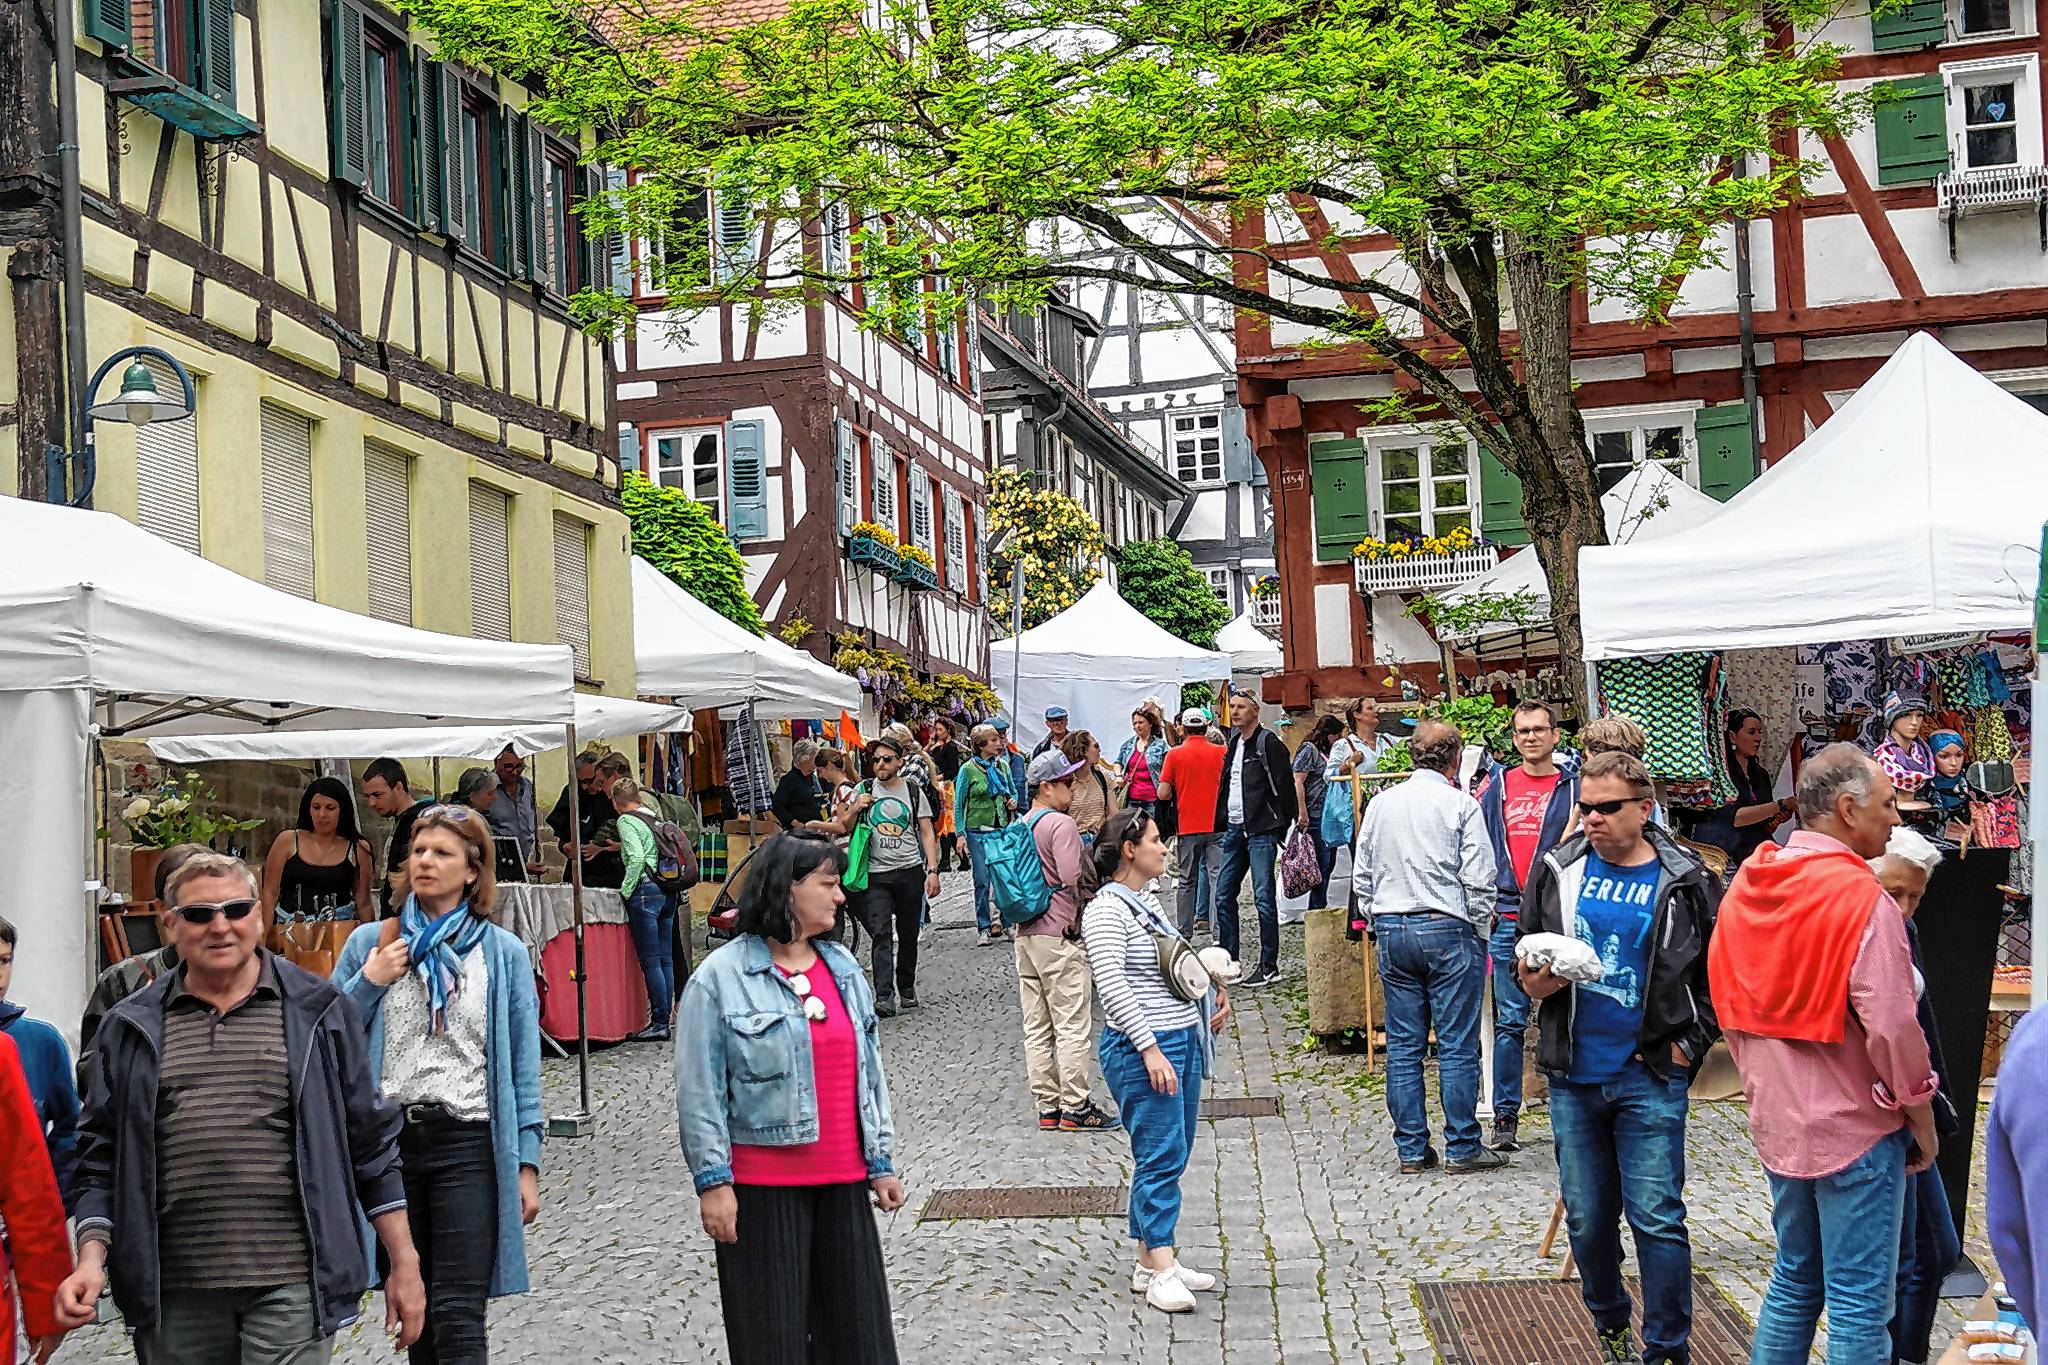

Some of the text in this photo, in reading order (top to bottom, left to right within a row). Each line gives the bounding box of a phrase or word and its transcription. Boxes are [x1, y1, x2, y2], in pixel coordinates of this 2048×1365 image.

[1902, 631, 1970, 647] Willkommen
[880, 838, 902, 848] 1UP
[1580, 876, 1654, 906] ERLIN
